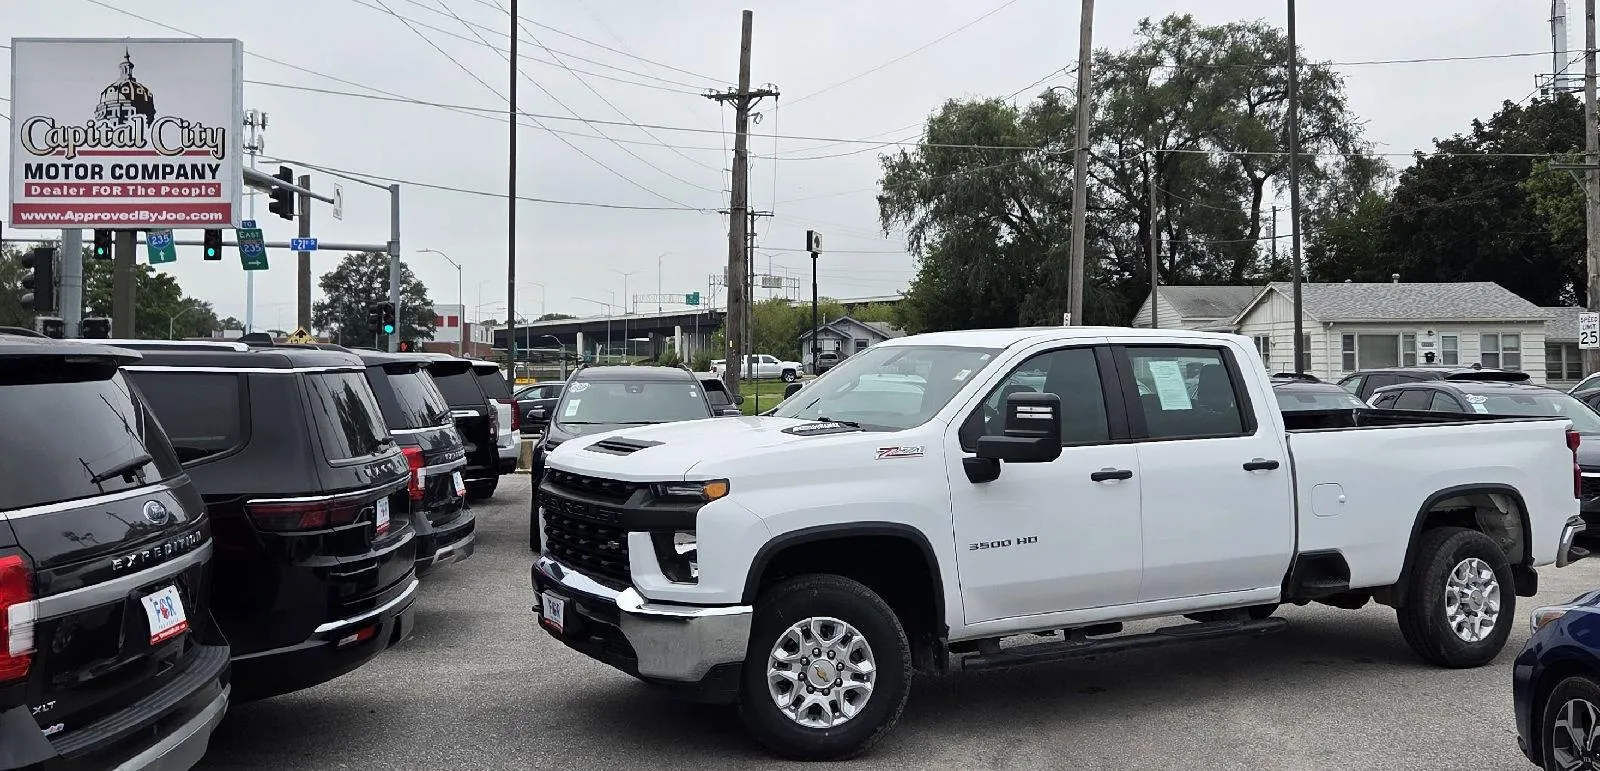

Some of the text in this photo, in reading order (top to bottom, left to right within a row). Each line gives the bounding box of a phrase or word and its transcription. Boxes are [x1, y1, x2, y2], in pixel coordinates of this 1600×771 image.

[20, 115, 226, 160] Capital City
[24, 163, 221, 180] MOTOR COMPANY
[31, 185, 216, 198] Dealer FOR The People
[20, 210, 223, 226] www.ApprovedByJoe.com
[151, 235, 170, 246] 235
[239, 231, 260, 240] EAST
[243, 243, 261, 254] 235
[1580, 330, 1598, 345] 25
[969, 536, 1038, 551] 3500 HD
[33, 700, 57, 715] XLT
